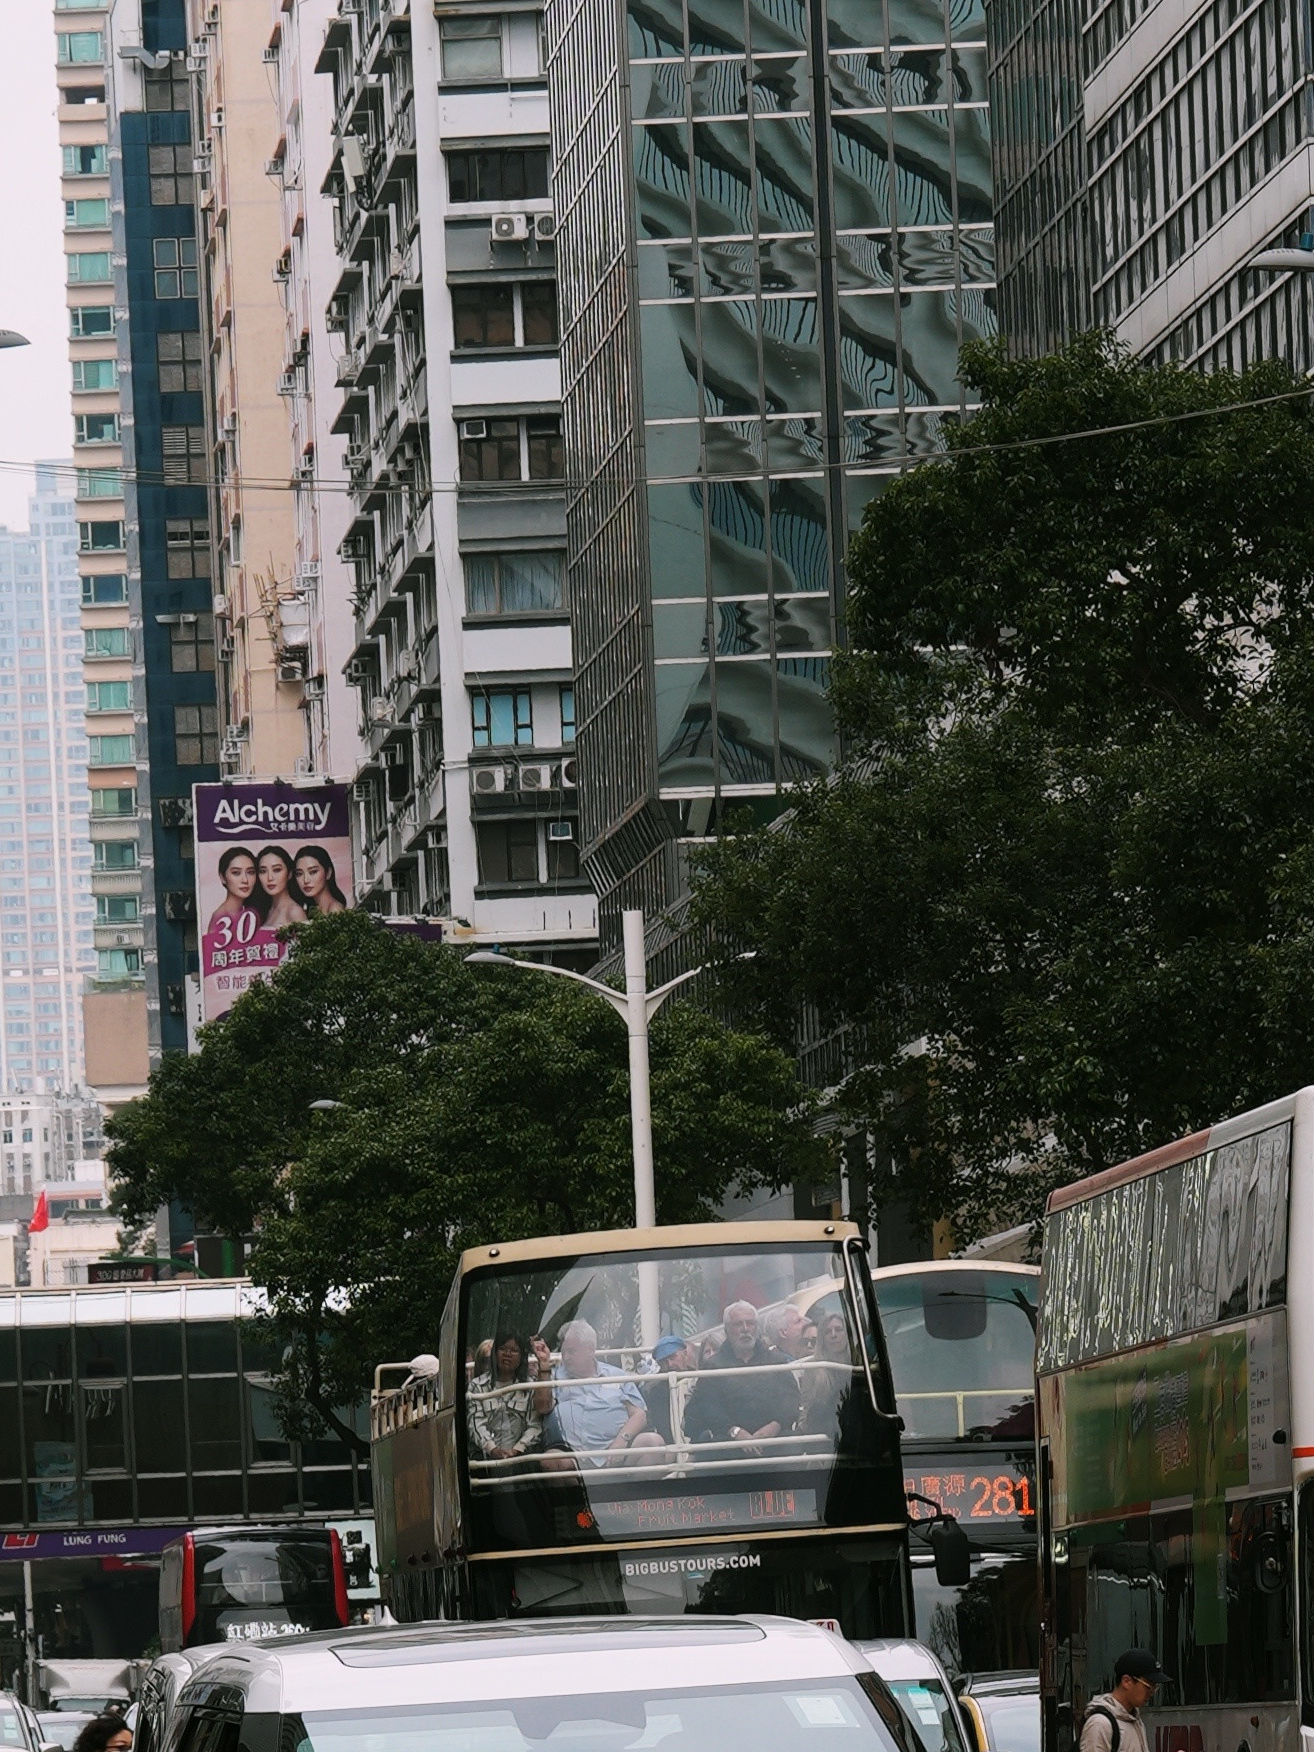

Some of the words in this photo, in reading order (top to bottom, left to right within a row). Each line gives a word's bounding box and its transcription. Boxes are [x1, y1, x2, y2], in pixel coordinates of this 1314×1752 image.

[213, 798, 332, 831] Alchemy
[213, 909, 258, 949] 30
[636, 1498, 674, 1513] Mong
[678, 1496, 705, 1510] Kok
[969, 1474, 1035, 1518] 281
[682, 1508, 735, 1524] Market
[63, 1534, 92, 1547] LUNG
[97, 1532, 127, 1545] FUNG
[624, 1554, 762, 1577] BIGBUSTOURS.COM
